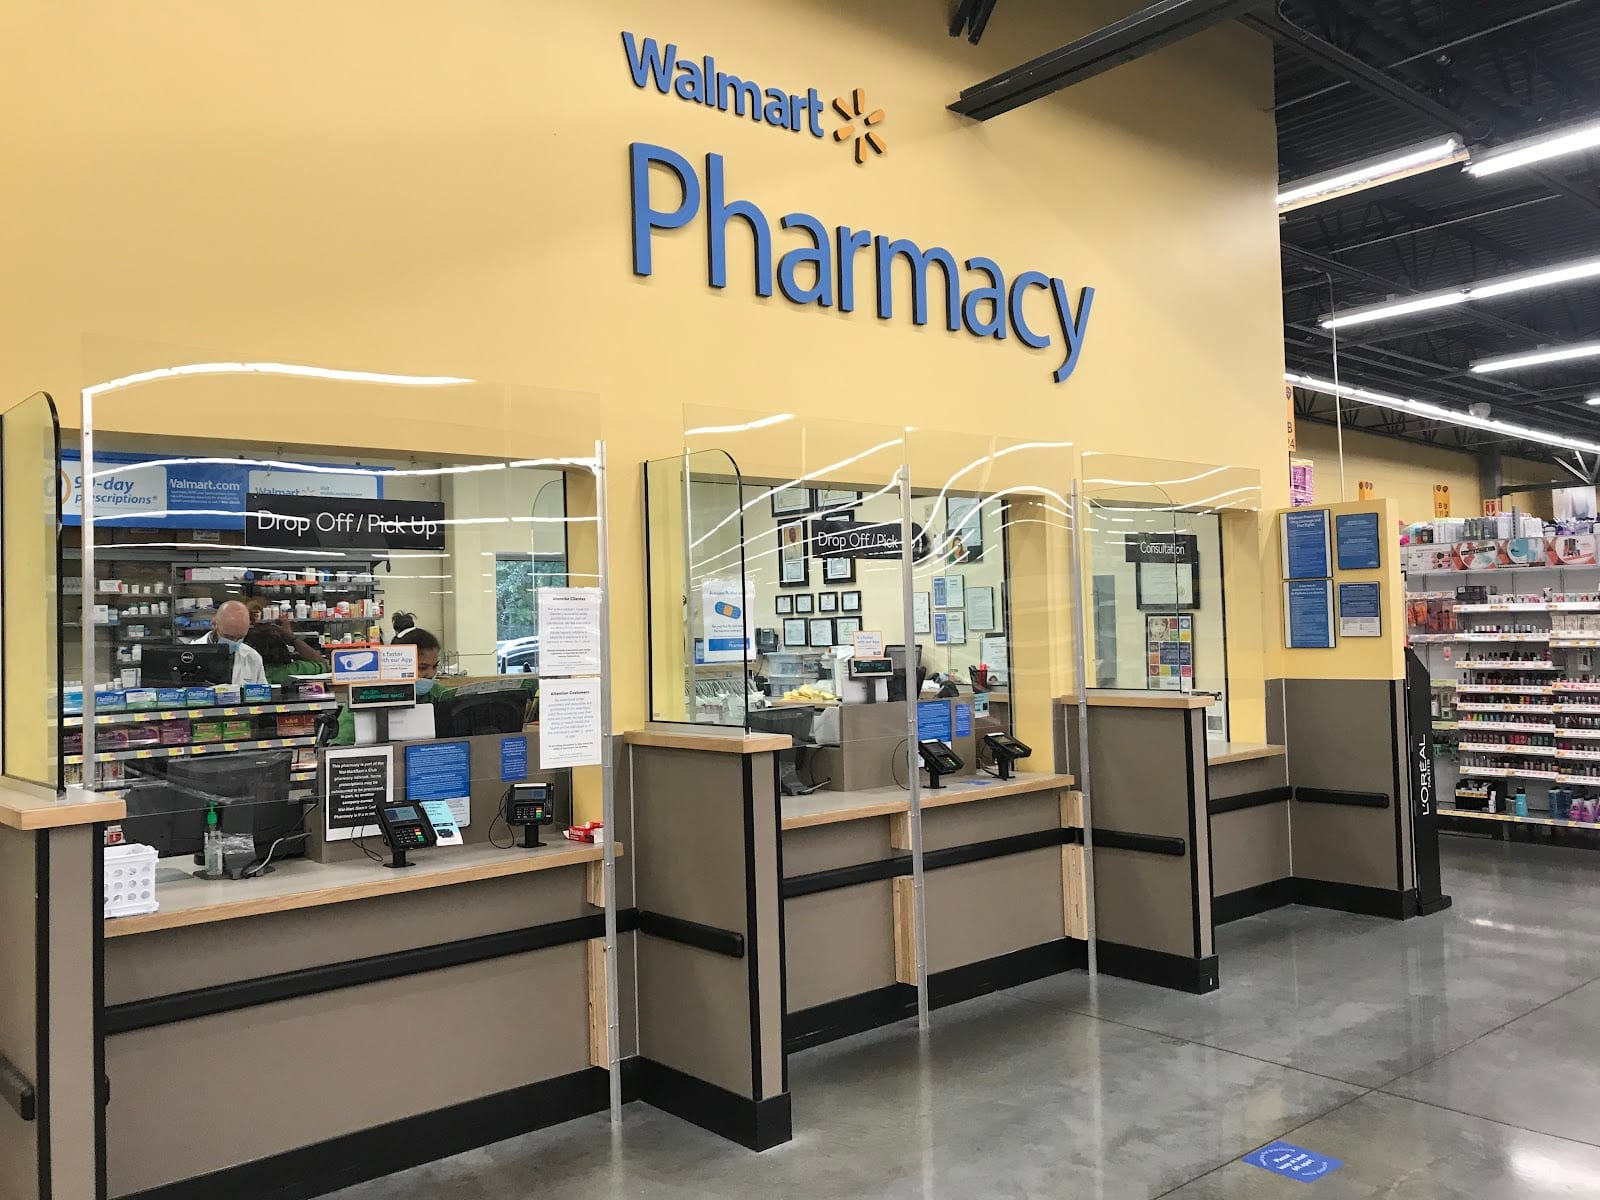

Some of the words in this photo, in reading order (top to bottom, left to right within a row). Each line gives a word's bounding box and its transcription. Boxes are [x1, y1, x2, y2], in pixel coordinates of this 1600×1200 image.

[621, 31, 825, 138] Walmart
[629, 142, 1095, 383] Pharmacy
[74, 475, 134, 494] 9-day
[257, 509, 311, 537] Drop
[316, 511, 355, 533] Off
[367, 513, 406, 535] Pick
[411, 515, 438, 541] Up
[818, 532, 847, 551] Drop
[849, 532, 870, 547] Off
[876, 533, 898, 549] Pick
